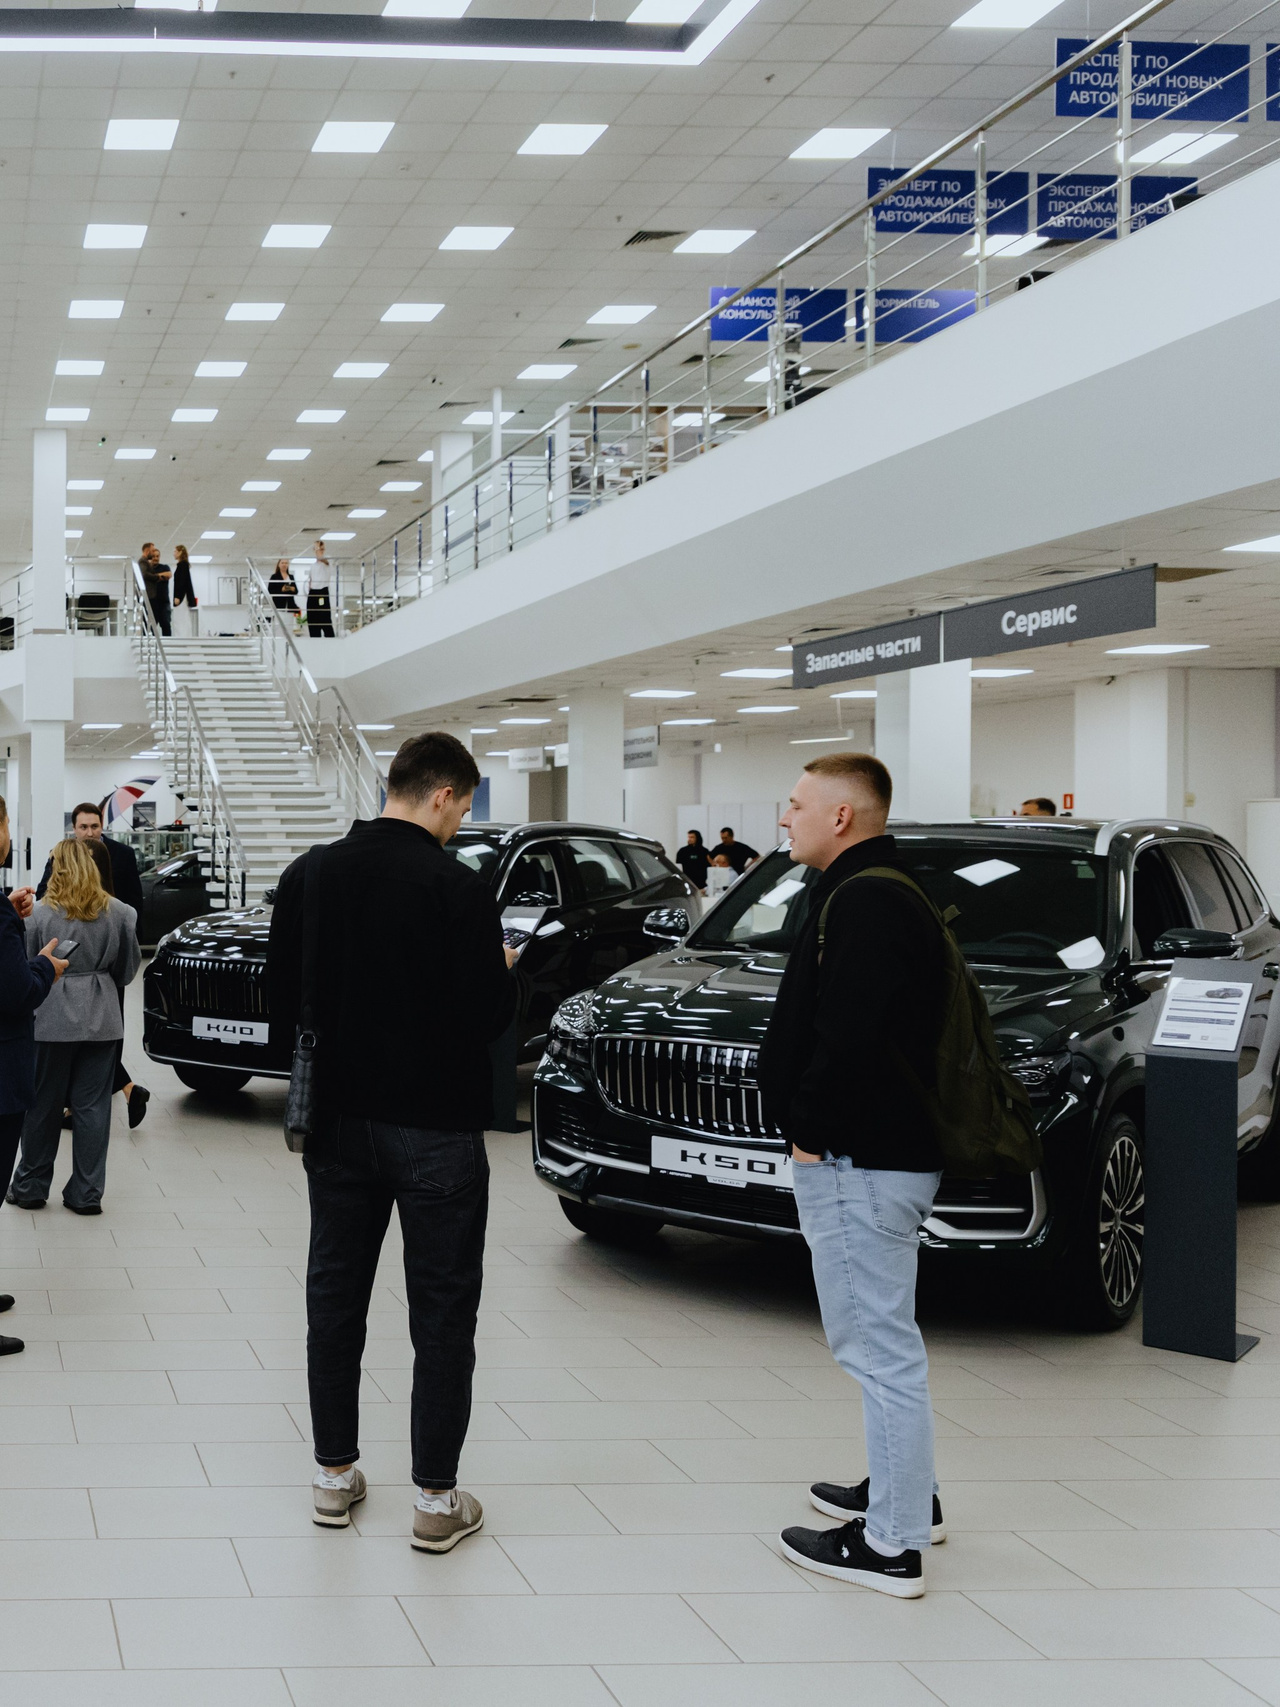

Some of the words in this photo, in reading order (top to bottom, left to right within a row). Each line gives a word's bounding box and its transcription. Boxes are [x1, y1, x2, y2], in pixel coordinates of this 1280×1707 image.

[1145, 55, 1169, 69] ПО
[1166, 75, 1223, 90] НОВЫХ
[941, 181, 961, 193] ПО
[958, 197, 1007, 210] НОЫХ
[1047, 215, 1147, 229] АВТОМОБЕЙ
[1001, 603, 1078, 637] Сервис
[805, 645, 875, 674] Запасные
[875, 635, 922, 659] части
[206, 1023, 254, 1036] K40
[680, 1149, 776, 1175] K50
